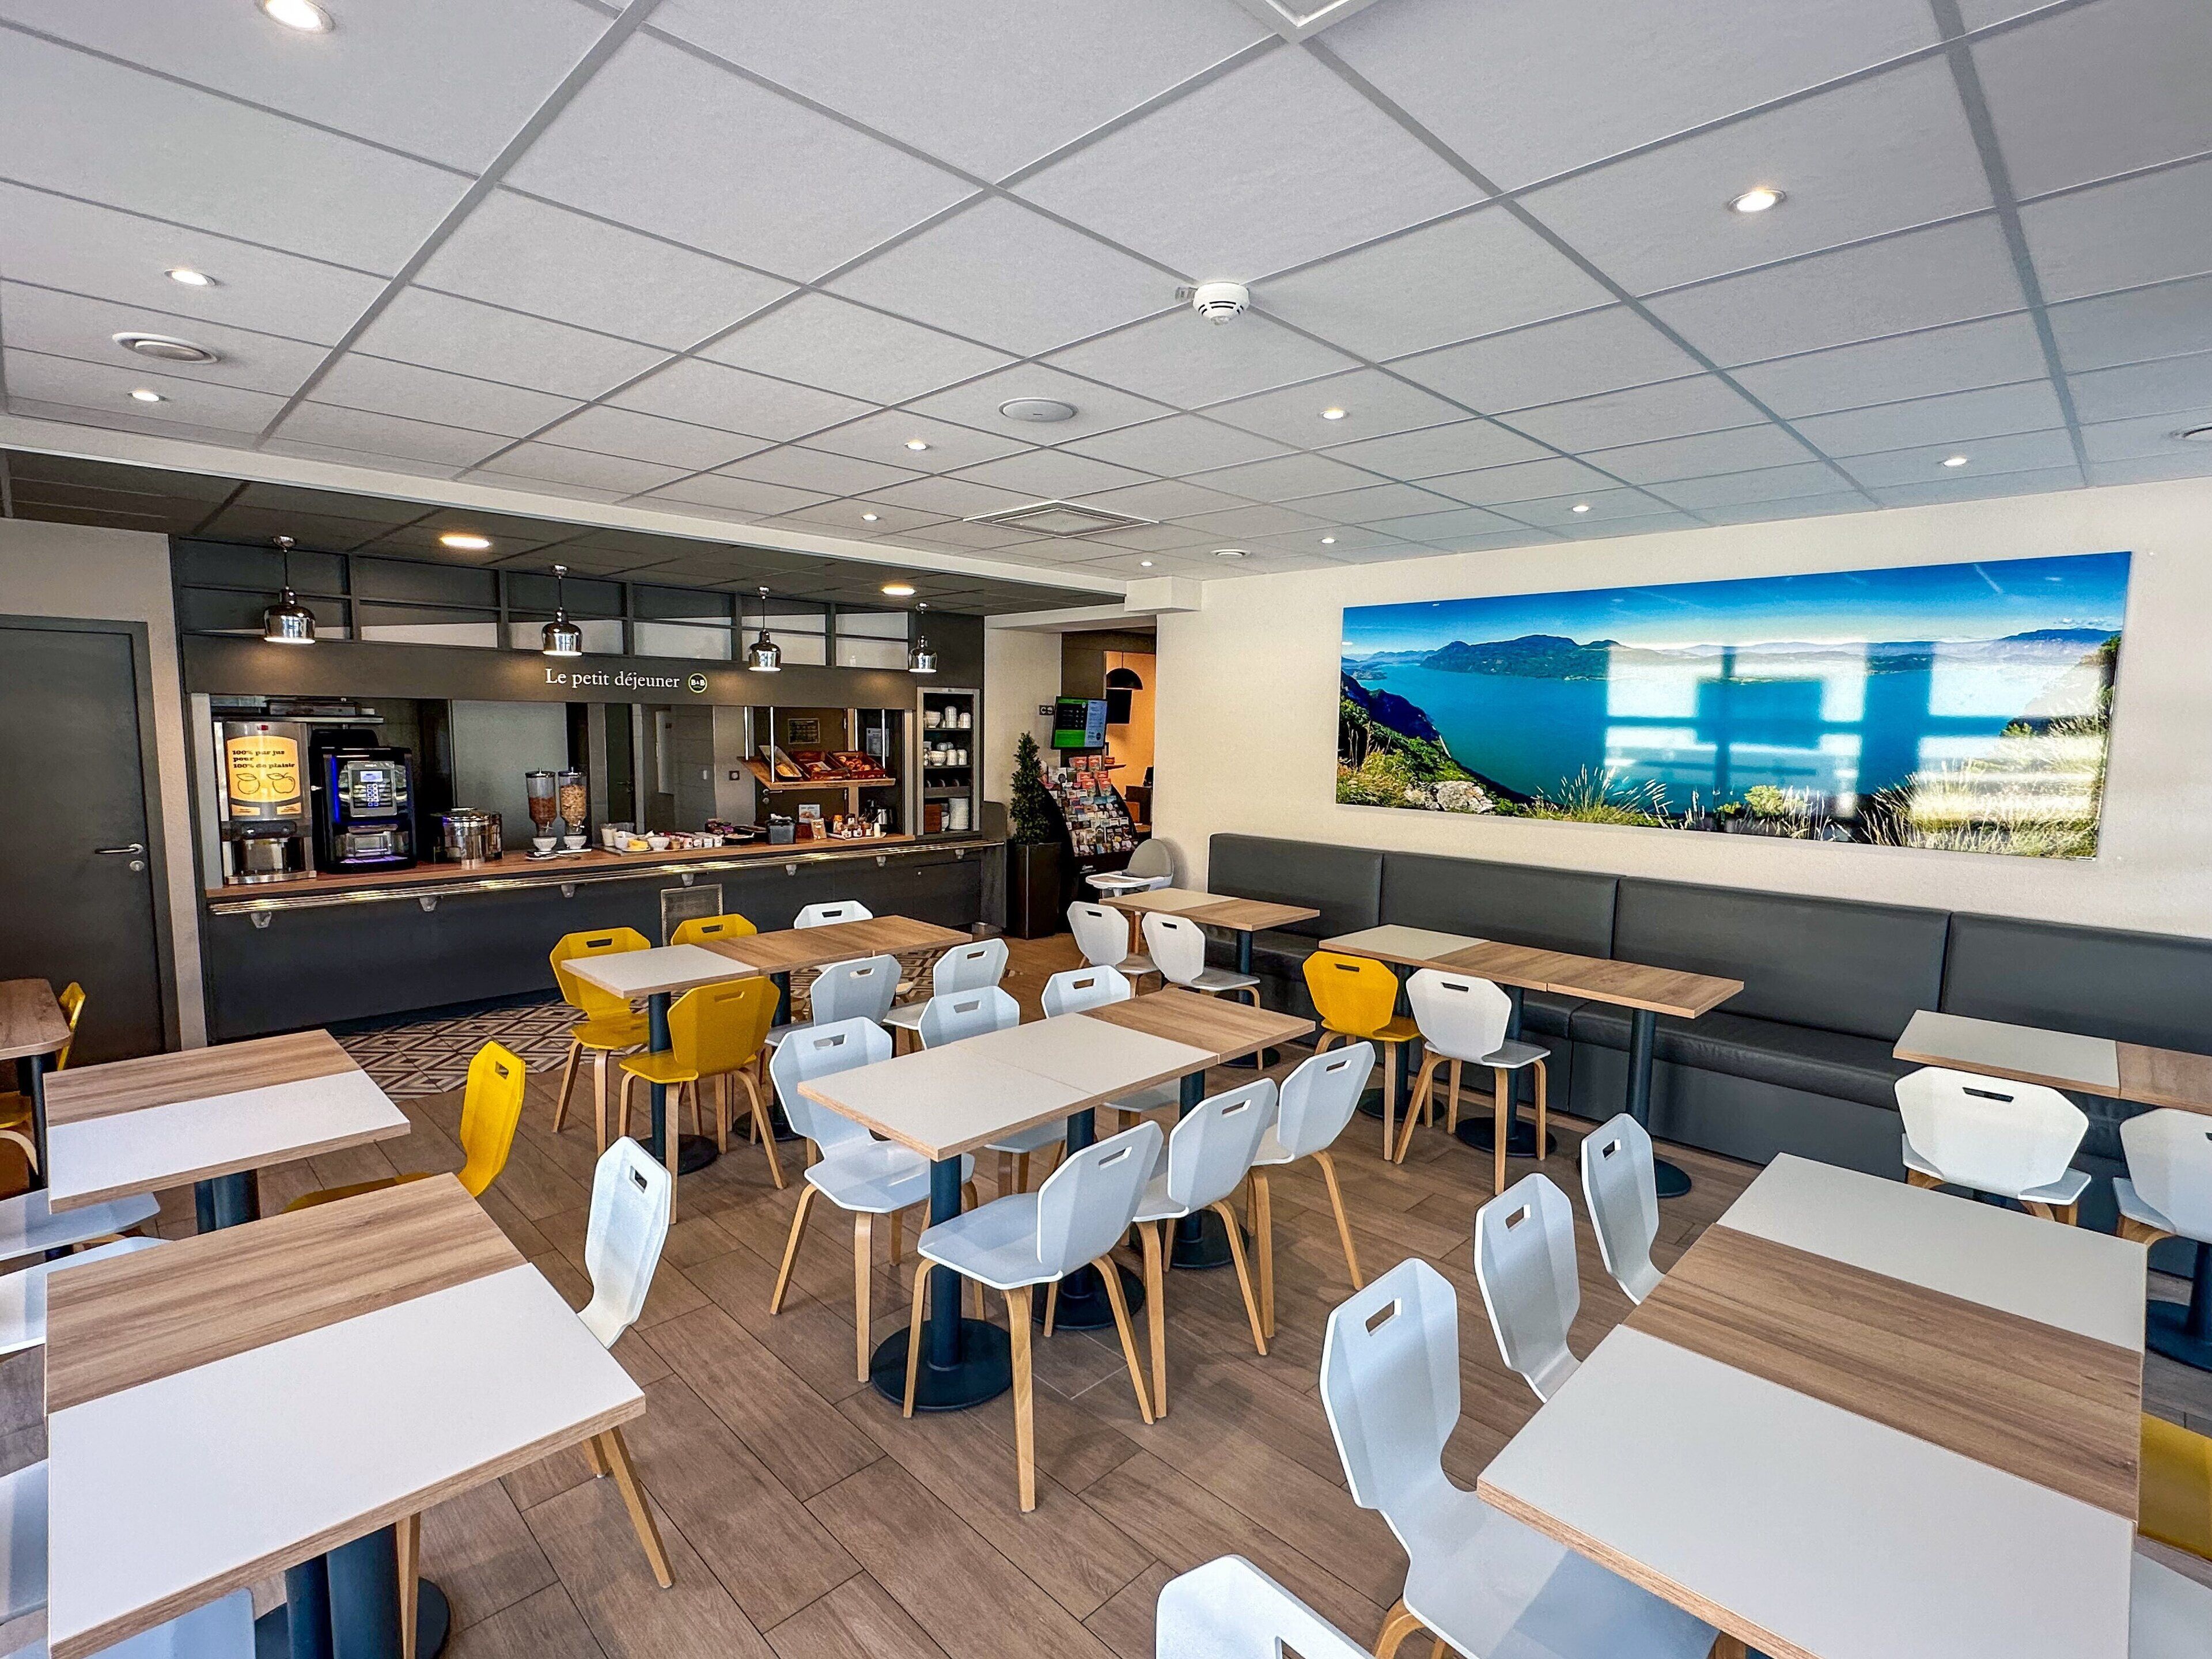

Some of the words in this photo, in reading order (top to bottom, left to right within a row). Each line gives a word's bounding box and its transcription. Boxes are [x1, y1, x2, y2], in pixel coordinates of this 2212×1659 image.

[545, 668, 567, 684] Le
[571, 671, 609, 688] petit
[614, 671, 680, 690] déjeuner
